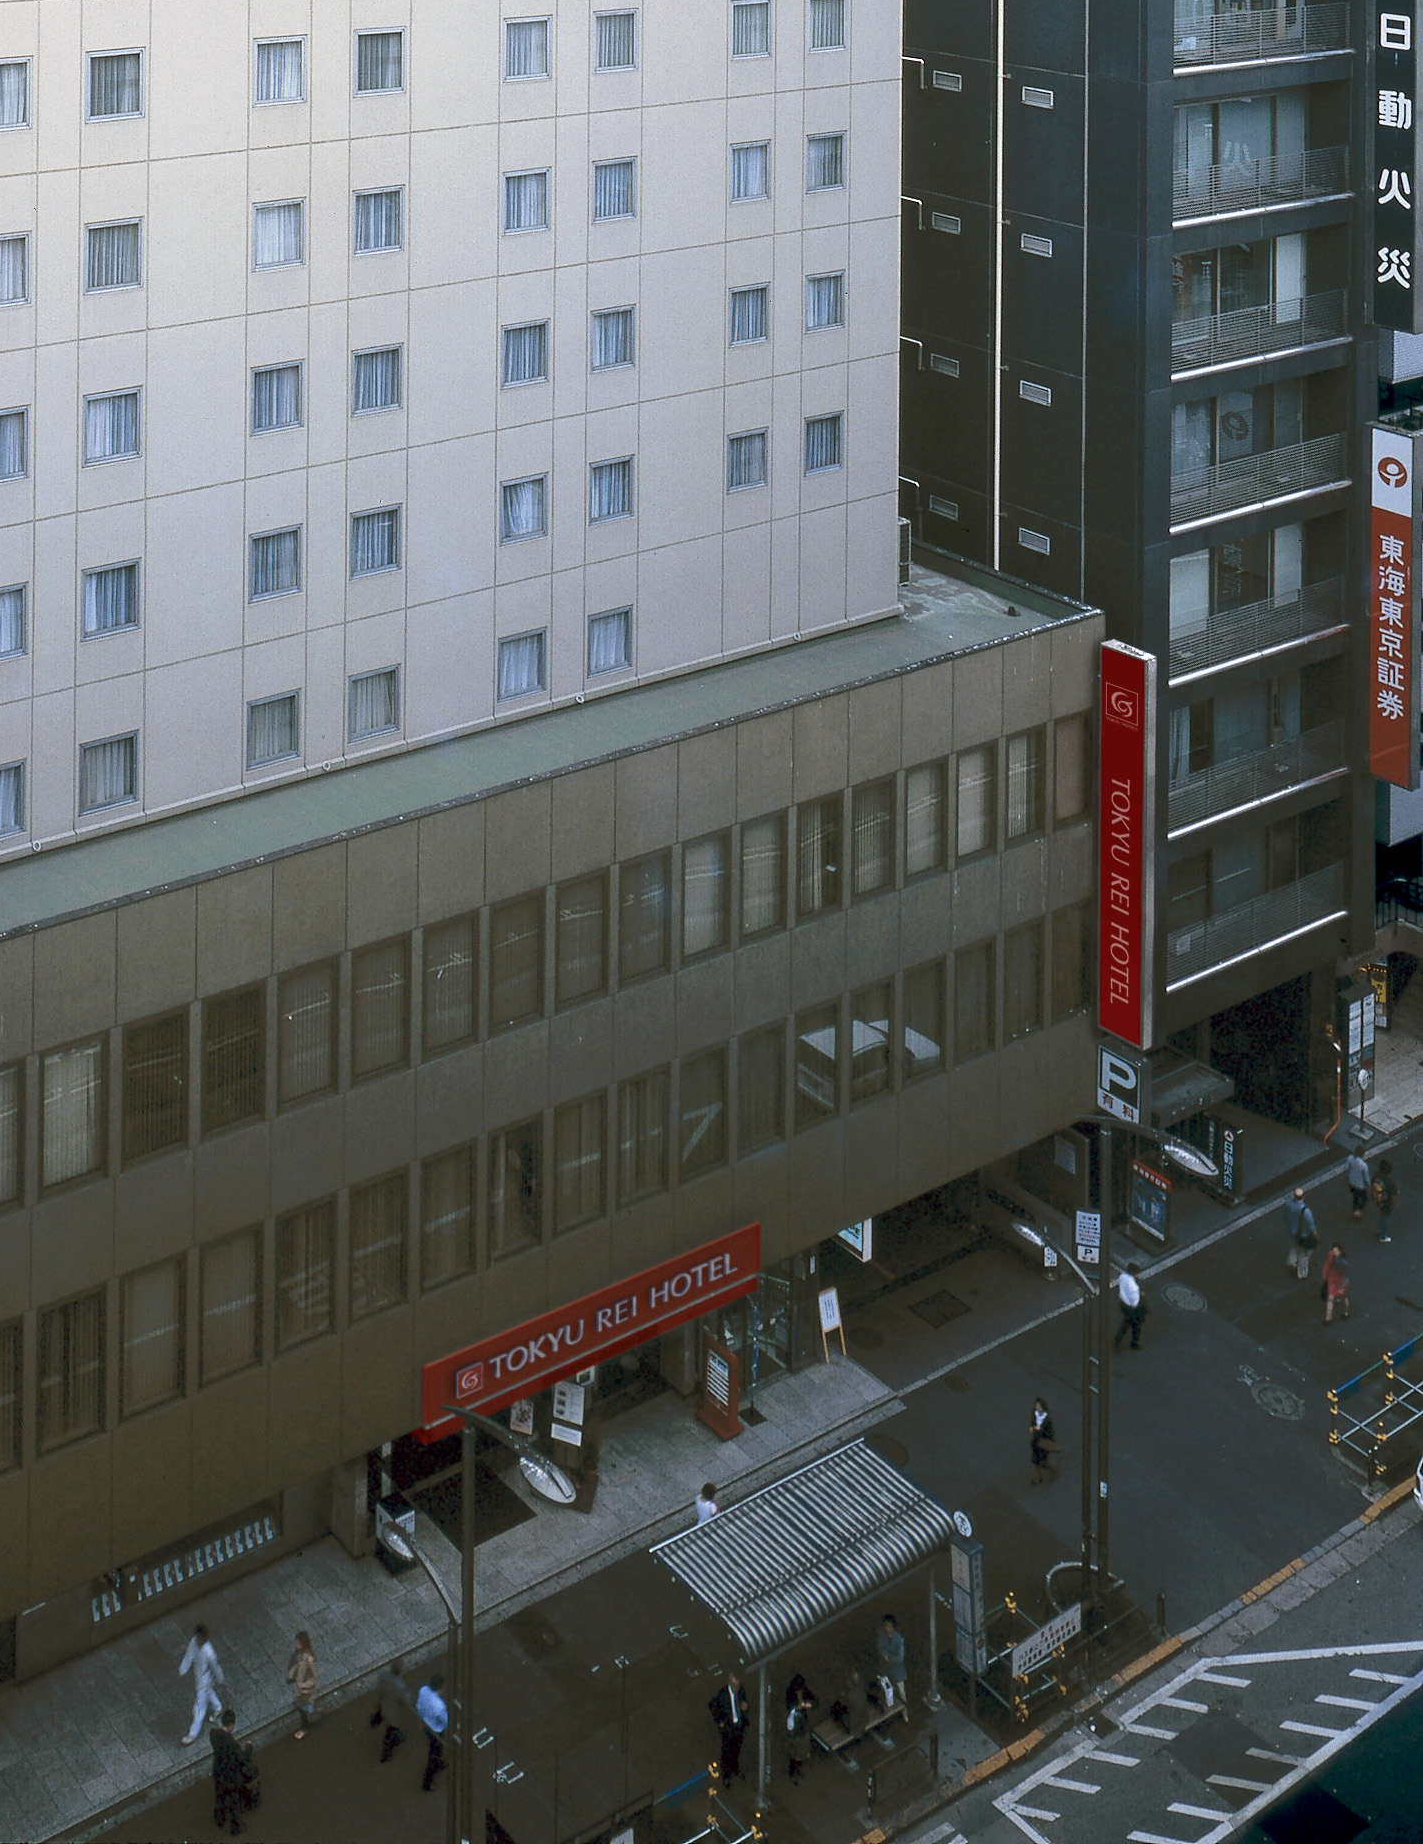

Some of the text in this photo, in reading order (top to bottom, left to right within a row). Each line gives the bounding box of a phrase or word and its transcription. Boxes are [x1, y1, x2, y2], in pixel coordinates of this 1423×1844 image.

[1377, 12, 1413, 291] 日動火災
[1376, 533, 1407, 722] 東海東京証券
[1109, 777, 1130, 1006] TOKYU REI HOTEL
[1101, 1050, 1137, 1092] P
[1102, 1092, 1135, 1122] 有料
[488, 1252, 738, 1380] TOKYU REI HOTEL
